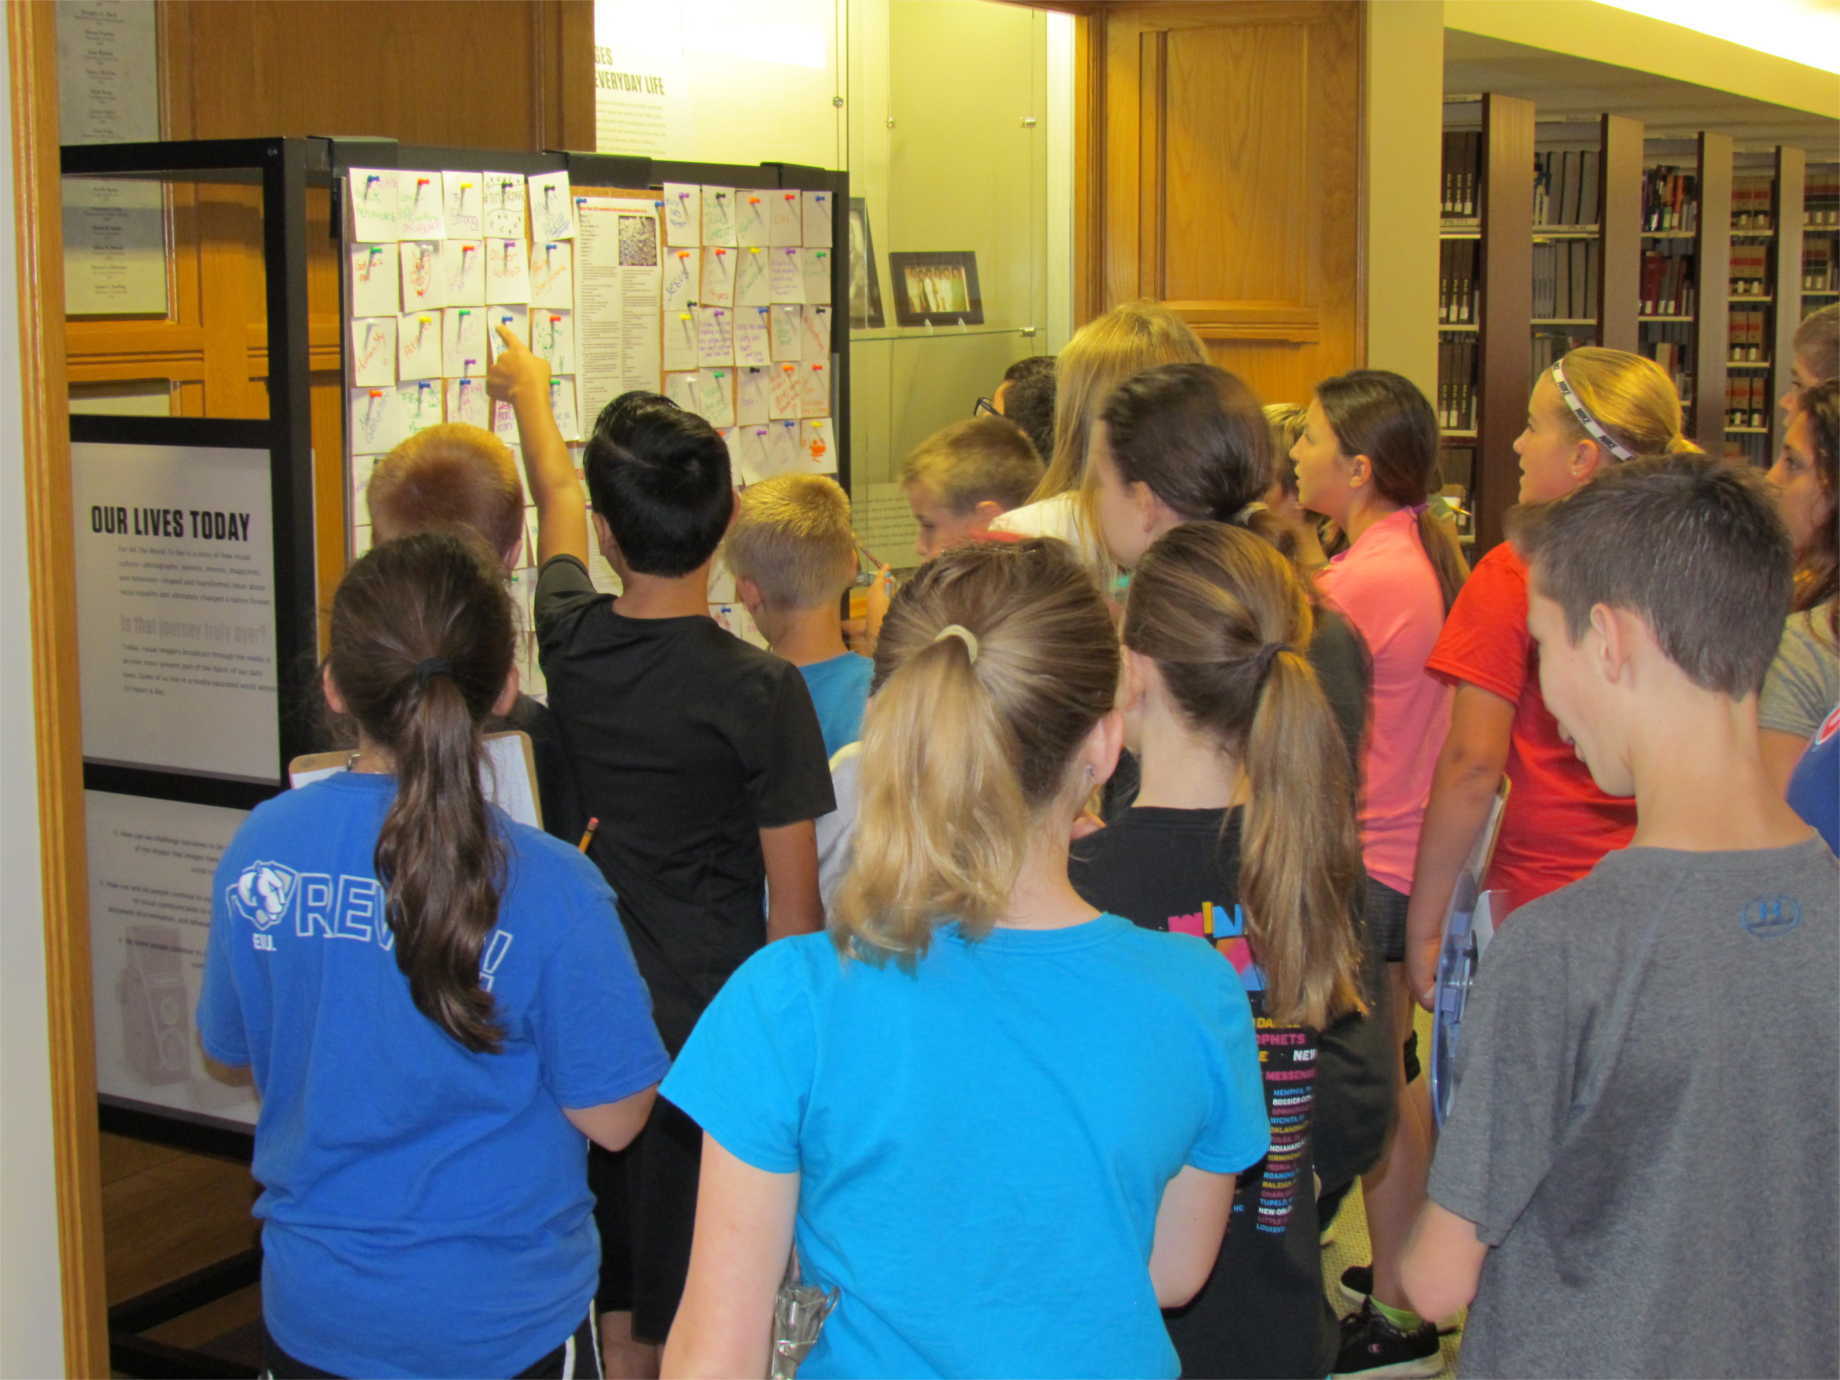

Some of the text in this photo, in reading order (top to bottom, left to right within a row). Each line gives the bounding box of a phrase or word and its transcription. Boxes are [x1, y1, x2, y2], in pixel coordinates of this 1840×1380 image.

[645, 76, 665, 95] LIFE
[91, 505, 251, 542] OUR LIVES TODAY
